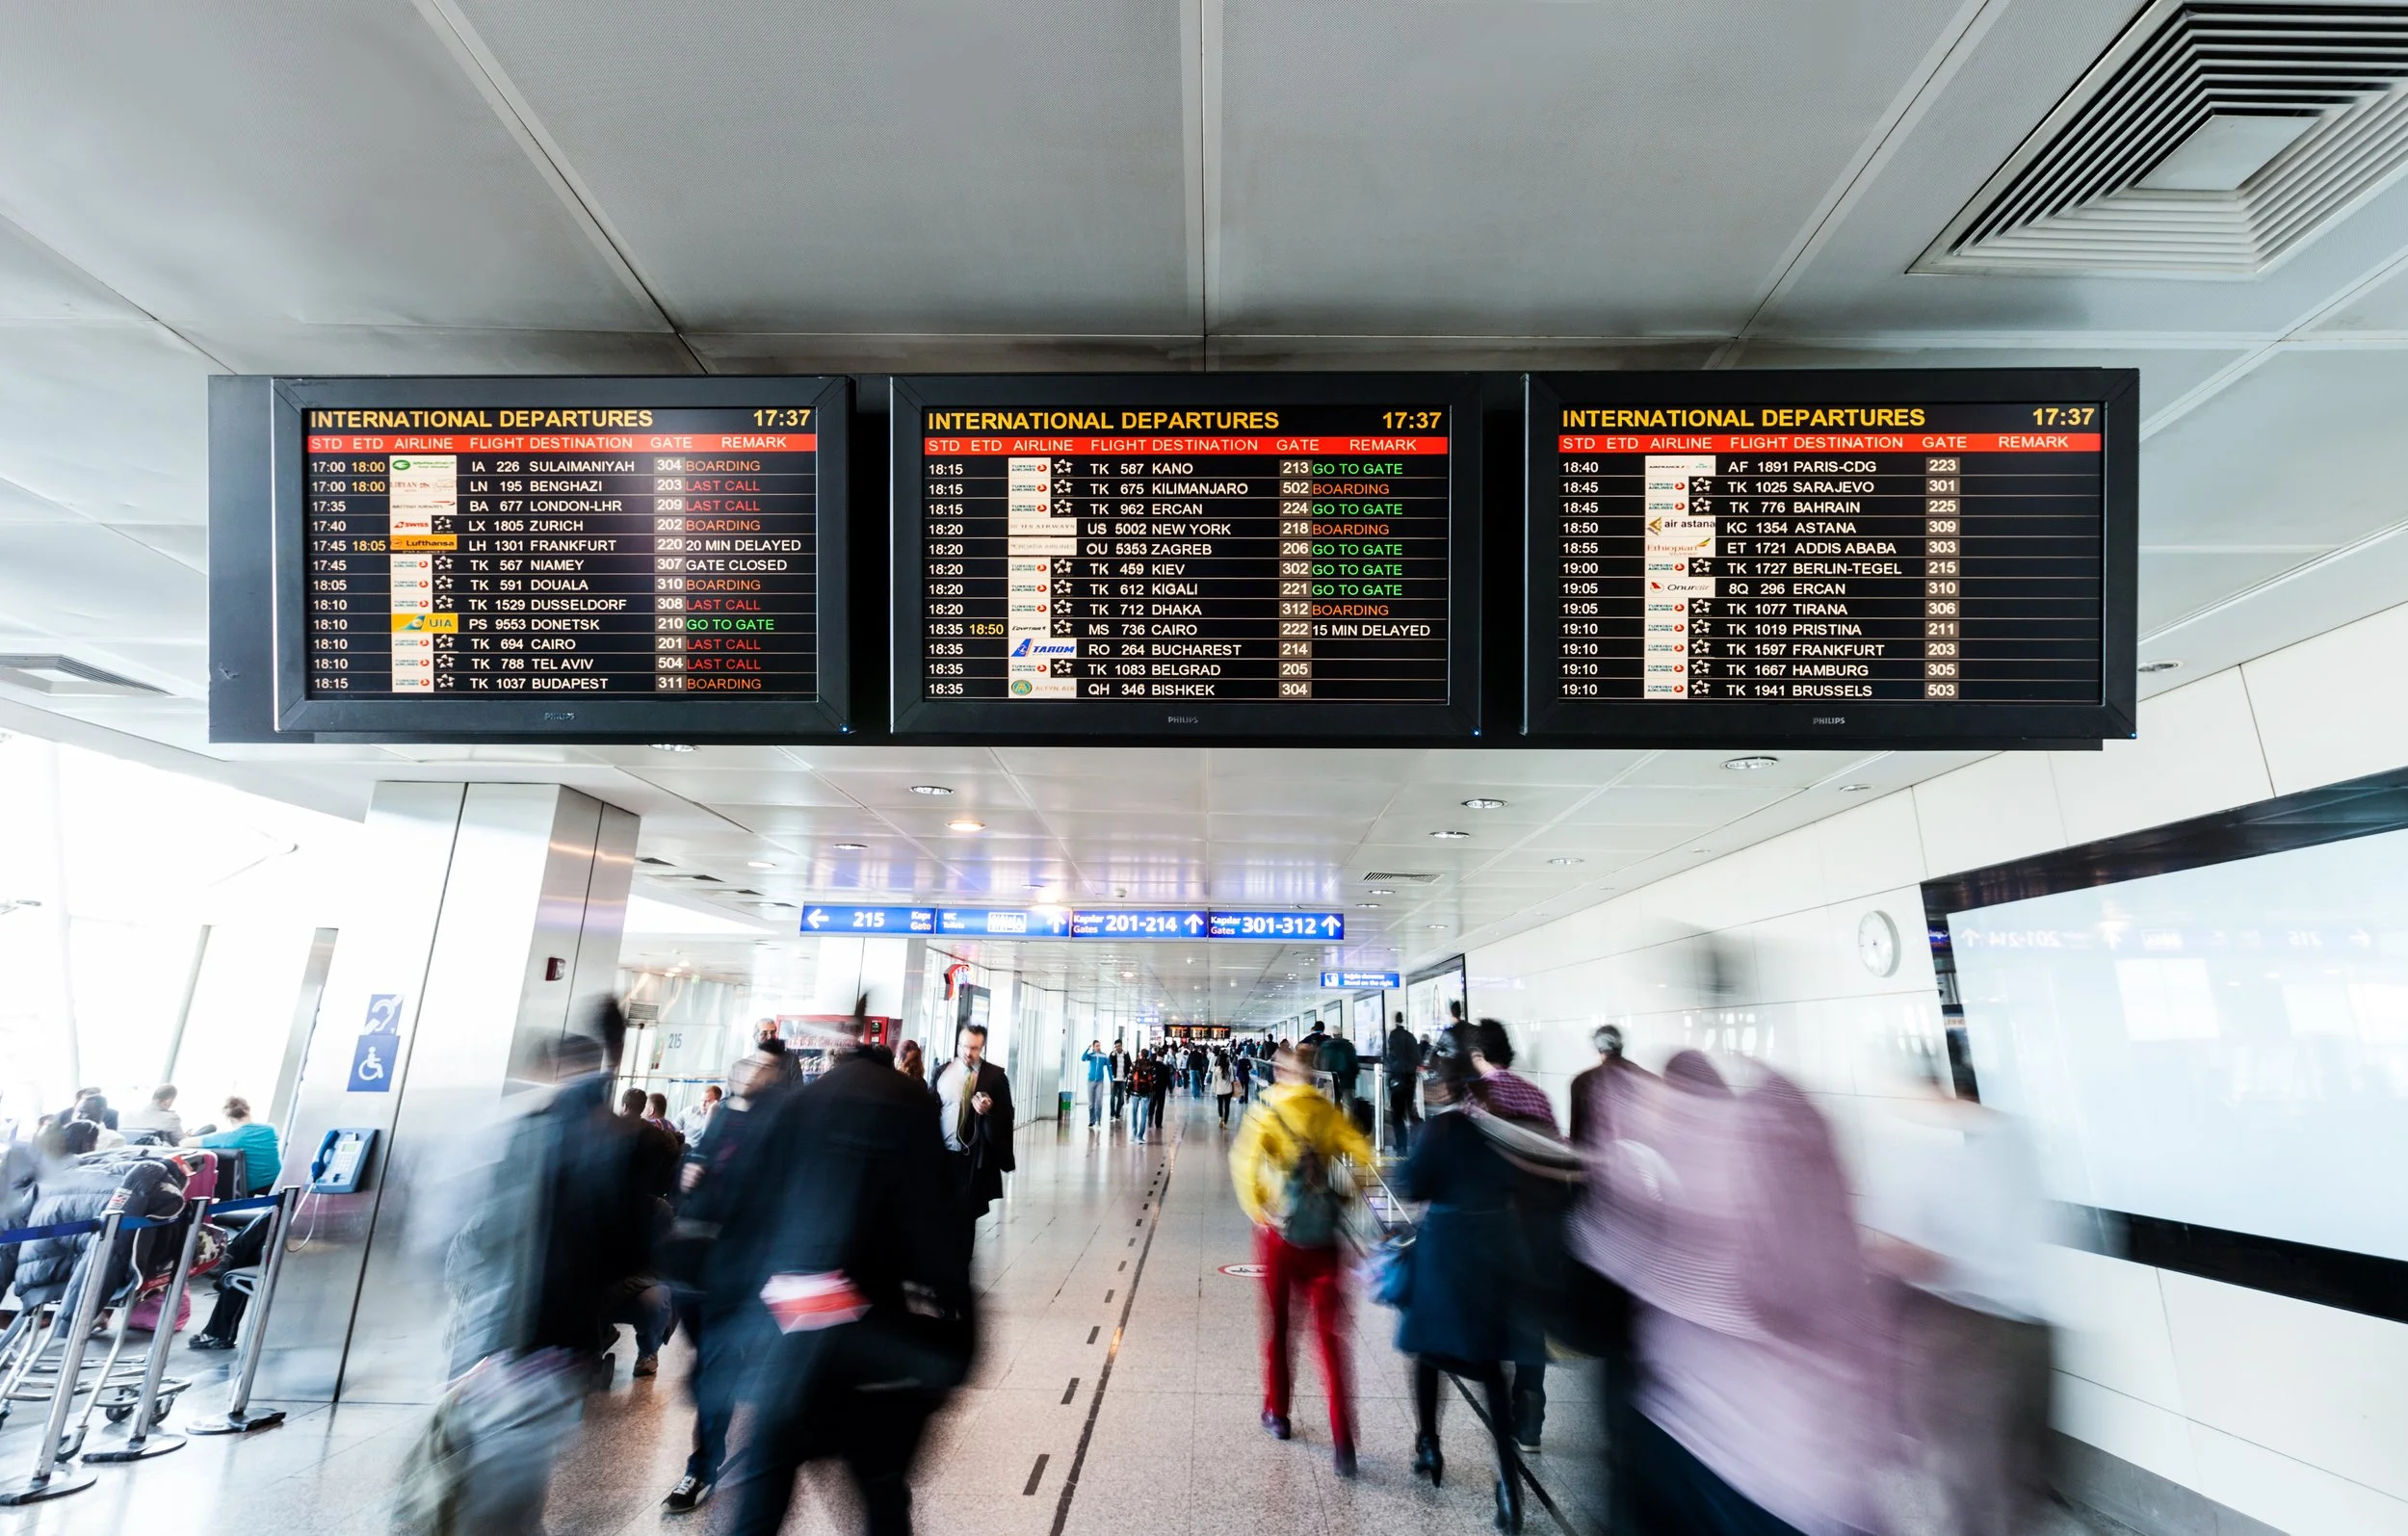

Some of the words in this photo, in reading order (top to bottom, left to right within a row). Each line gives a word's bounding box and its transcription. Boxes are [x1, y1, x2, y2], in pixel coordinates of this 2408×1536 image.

[311, 410, 493, 429] INTERNATIONAL
[499, 409, 654, 428] DEPARTURES
[753, 408, 811, 428] 17:37
[928, 411, 1114, 430] INTERNATIONAL
[1121, 411, 1280, 430] DEPARTURES
[1382, 411, 1442, 430] 17:37
[1562, 408, 1755, 428] INTERNATIONAL
[1762, 407, 1926, 428] DEPARTURES
[2032, 407, 2095, 427] 17:37
[311, 437, 343, 451] STD
[353, 437, 384, 451] ETD
[393, 436, 454, 450] AIRLINE
[469, 436, 525, 450] FLIGHT
[530, 436, 634, 450] DESTINATION
[649, 436, 693, 449] GATE
[720, 435, 787, 449] REMARK
[928, 439, 960, 453] STD
[970, 439, 1003, 453] ETD
[1012, 439, 1074, 452] AIRLINE
[1090, 438, 1147, 452] FLIGHT
[1152, 438, 1259, 452] DESTINATION
[1275, 438, 1320, 452] GATE
[1349, 438, 1417, 452] REMARK
[1562, 436, 1596, 450] STD
[1606, 436, 1639, 450] ETD
[1649, 436, 1713, 450] AIRLINE
[1730, 436, 1789, 450] FLIGHT
[1793, 436, 1904, 450] DESTINATION
[1922, 435, 1968, 449] GATE
[1998, 435, 2069, 449] REMARK
[311, 460, 347, 474] 17:00
[351, 460, 386, 473] 18:00
[471, 460, 486, 473] IA
[496, 460, 521, 473] 226
[529, 459, 636, 473] SULAIMANIYAH
[656, 458, 683, 471] 304
[684, 458, 761, 473] BOARDING
[312, 520, 347, 533] 17:40
[468, 519, 486, 533] LX
[493, 519, 525, 533] 1805
[529, 519, 584, 533] ZURICH
[656, 518, 683, 531] 202
[684, 518, 761, 533] BOARDING
[929, 523, 964, 535] 18:20
[1086, 522, 1108, 535] US
[1114, 522, 1147, 535] 5002
[1151, 523, 1187, 535] NEW
[1189, 523, 1232, 535] YORK
[1282, 522, 1309, 534] 218
[1311, 523, 1390, 536] BOARDING
[1562, 521, 1599, 534] 18:50
[1726, 521, 1748, 534] KC
[1755, 521, 1789, 534] 1354
[1793, 521, 1857, 534] ASTANA
[1928, 520, 1957, 534] 309
[1664, 519, 1678, 528] air
[312, 539, 348, 552] 17:45
[352, 539, 387, 552] 18:05
[468, 539, 487, 552] LH
[494, 539, 524, 552] 1301
[530, 539, 617, 552] FRANKFURT
[656, 537, 684, 551] 220
[684, 538, 703, 552] 20
[704, 538, 731, 552] MIN
[734, 538, 801, 552] DELAYED
[1562, 541, 1599, 555] 18:55
[1726, 541, 1747, 555] ET
[1755, 541, 1786, 555] 1721
[1793, 541, 1843, 555] ADDIS
[1844, 541, 1898, 555] ABABA
[1928, 540, 1957, 554] 303
[1647, 544, 1698, 553] Ethiopian
[1562, 561, 1599, 575] 19:00
[1726, 561, 1747, 575] TK
[1755, 561, 1788, 575] 1727
[1793, 561, 1903, 575] BERLIN-TEGEL
[1928, 560, 1957, 574] 215
[1562, 582, 1599, 595] 19:05
[1728, 583, 1749, 595] 8Q
[1760, 583, 1786, 595] 296
[1793, 583, 1846, 595] ERCAN
[1928, 581, 1956, 595] 310
[313, 618, 349, 631] 18:10
[468, 617, 488, 631] PS
[494, 617, 527, 631] 9553
[531, 618, 600, 631] DONETSK
[657, 616, 684, 630] 210
[684, 617, 710, 631] GO
[711, 617, 733, 631] TO
[735, 617, 775, 631] GATE
[429, 618, 453, 628] UIA
[929, 623, 964, 636] 18:35
[969, 623, 1005, 636] 18:50
[1087, 623, 1111, 636] MS
[1120, 623, 1146, 637] 736
[1150, 623, 1198, 637] CAIRO
[1281, 622, 1309, 636] 222
[1312, 624, 1328, 637] 15
[1331, 624, 1358, 637] MIN
[1361, 624, 1431, 637] DELAYED
[929, 642, 964, 656] 18:35
[1087, 643, 1111, 656] RO
[1120, 643, 1146, 656] 264
[1151, 643, 1243, 657] BUCHAREST
[1281, 642, 1309, 656] 214
[1032, 645, 1076, 654] TAROM
[929, 683, 964, 695] 18:35
[1087, 683, 1111, 696] QH
[1120, 683, 1146, 696] 346
[1151, 683, 1216, 696] BISHKEK
[1281, 683, 1309, 696] 304
[1561, 683, 1598, 696] 19:10
[1725, 684, 1746, 696] TK
[1754, 684, 1785, 697] 1941
[1792, 684, 1873, 697] BRUSSELS
[1927, 683, 1955, 697] 503
[1167, 716, 1199, 724] PHILIPS
[1812, 716, 1846, 725] PHILIPS
[852, 911, 885, 927] 215
[910, 922, 931, 931] Gate
[1105, 914, 1178, 932] 201-214
[1242, 916, 1317, 934] 301-312
[1073, 924, 1099, 934] Gates
[1211, 925, 1236, 935] Gates
[667, 1032, 683, 1049] 215
